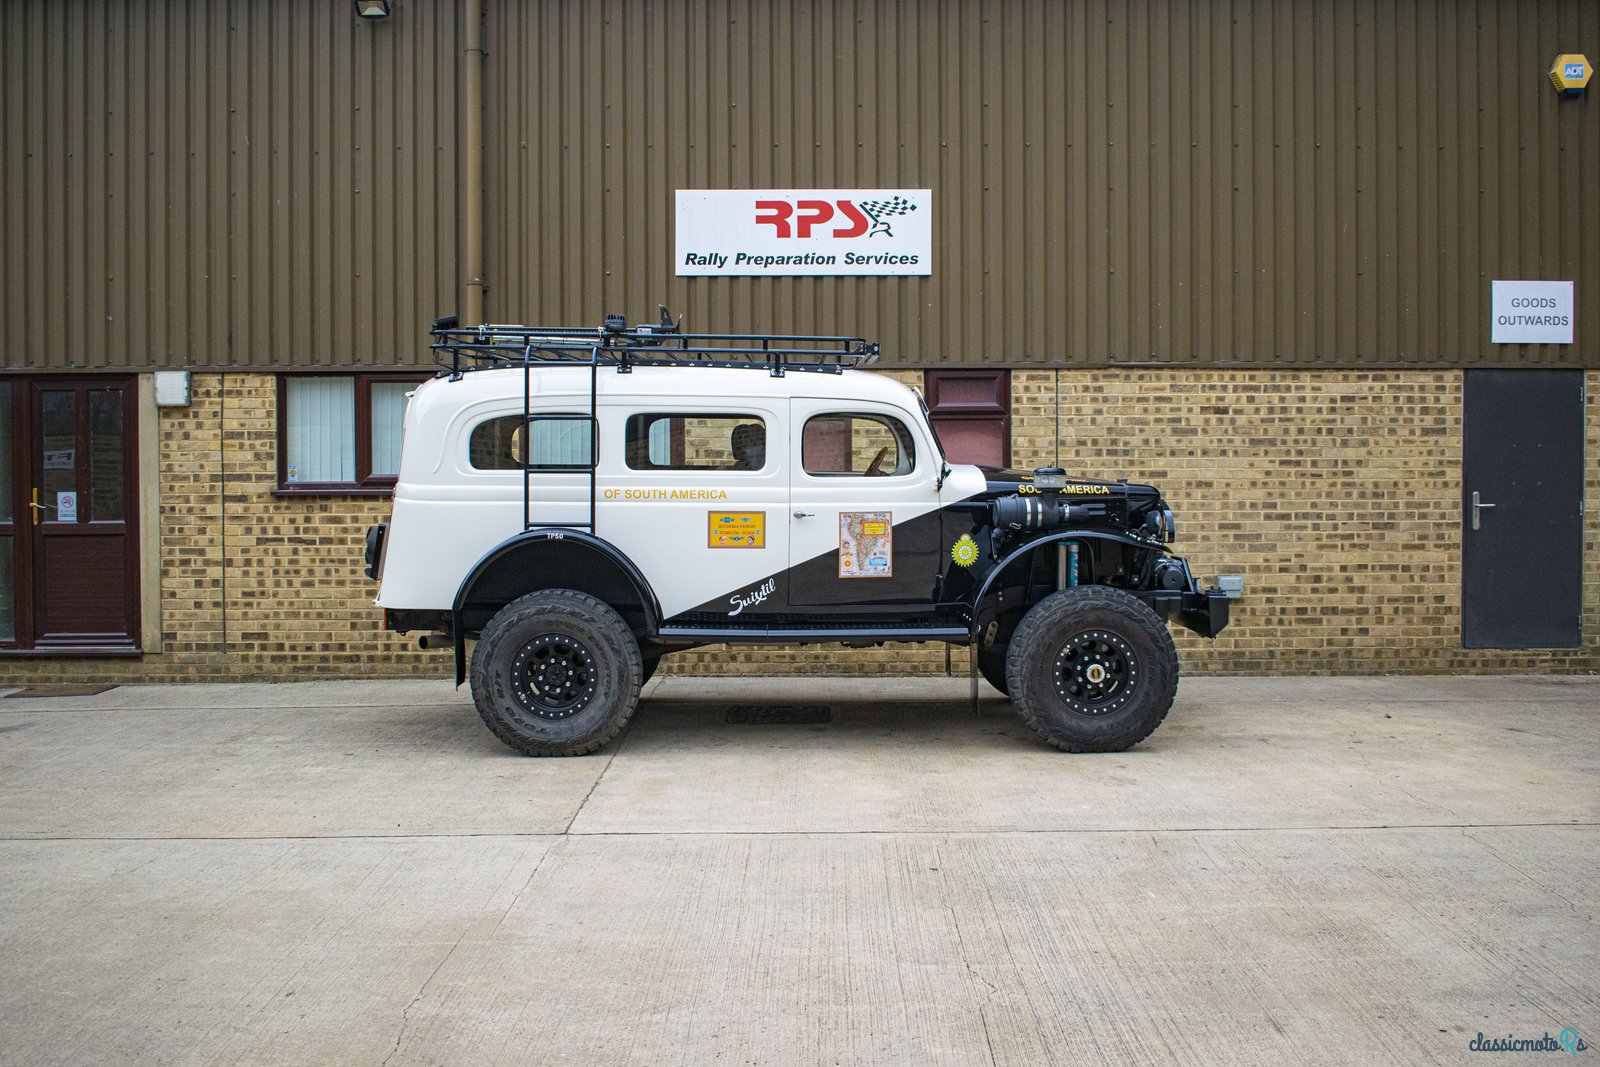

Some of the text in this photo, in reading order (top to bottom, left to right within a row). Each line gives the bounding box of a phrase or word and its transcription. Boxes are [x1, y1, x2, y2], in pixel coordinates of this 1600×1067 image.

[1565, 66, 1584, 76] ADT
[755, 200, 869, 239] RPS
[685, 252, 919, 268] Rally Preparation Services
[1511, 297, 1557, 308] GOODS
[1498, 315, 1569, 326] OUTWARDS
[604, 488, 727, 500] OF SOUTH AMERICA
